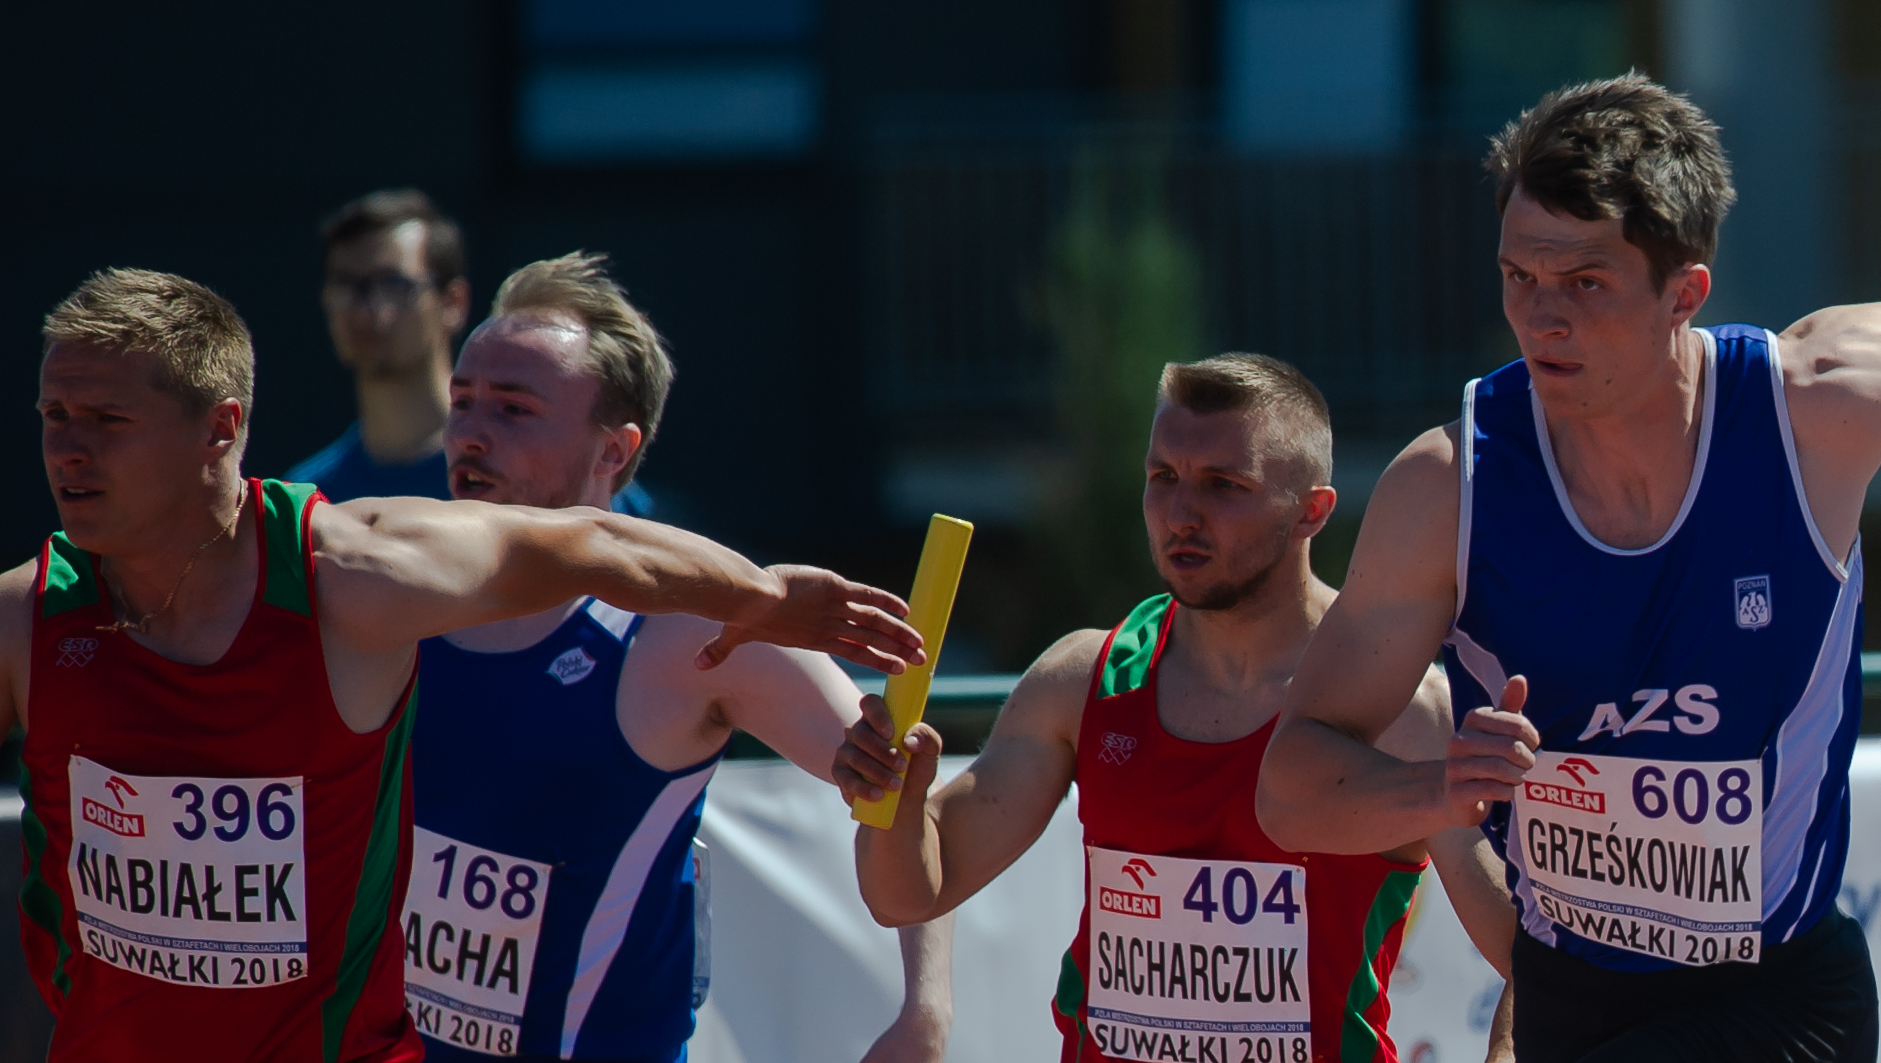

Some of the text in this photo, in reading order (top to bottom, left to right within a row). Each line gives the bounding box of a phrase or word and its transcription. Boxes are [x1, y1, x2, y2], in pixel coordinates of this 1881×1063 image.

[1576, 683, 1721, 742] AZS
[84, 802, 139, 835] ORLEN
[170, 782, 296, 843] 396
[1528, 783, 1601, 812] ORLEN
[1631, 764, 1753, 826] 608
[76, 841, 298, 922] NABIAŁEK
[431, 843, 539, 921] 168
[1526, 816, 1752, 903] GRZEŚKOWIAK
[1101, 891, 1157, 917] ORLEN
[1182, 865, 1302, 926] 404
[1597, 902, 1625, 913] POLSKI
[1735, 923, 1753, 931] 2018
[86, 928, 304, 986] SUWAŁKI 2018
[281, 944, 300, 953] 2018
[1538, 893, 1755, 964] SUWAŁKI 2018
[1097, 931, 1302, 1004] SACHARCZUK
[449, 1014, 514, 1054] 2018
[1287, 1023, 1304, 1032] 2018
